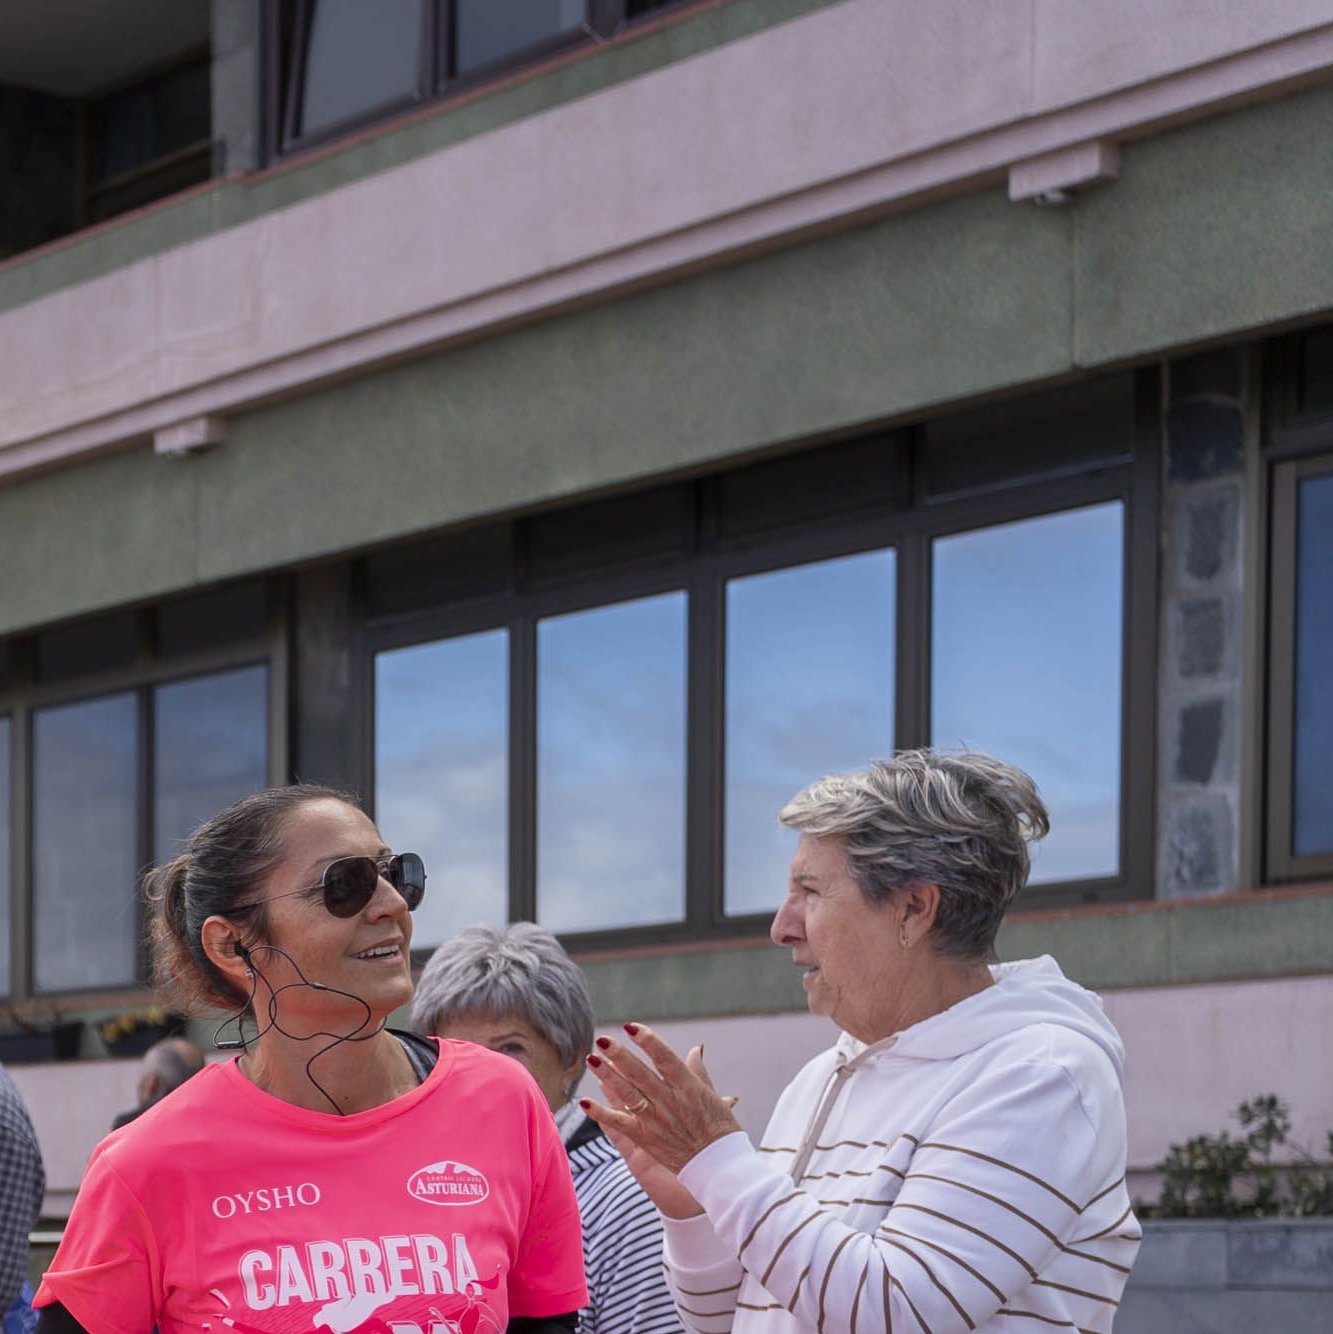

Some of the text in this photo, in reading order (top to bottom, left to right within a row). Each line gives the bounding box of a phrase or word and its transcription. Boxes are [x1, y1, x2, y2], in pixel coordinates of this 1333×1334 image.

[212, 1182, 321, 1219] OYSHO
[415, 1178, 484, 1196] ASTURIANA
[238, 1233, 483, 1312] CARRERA
